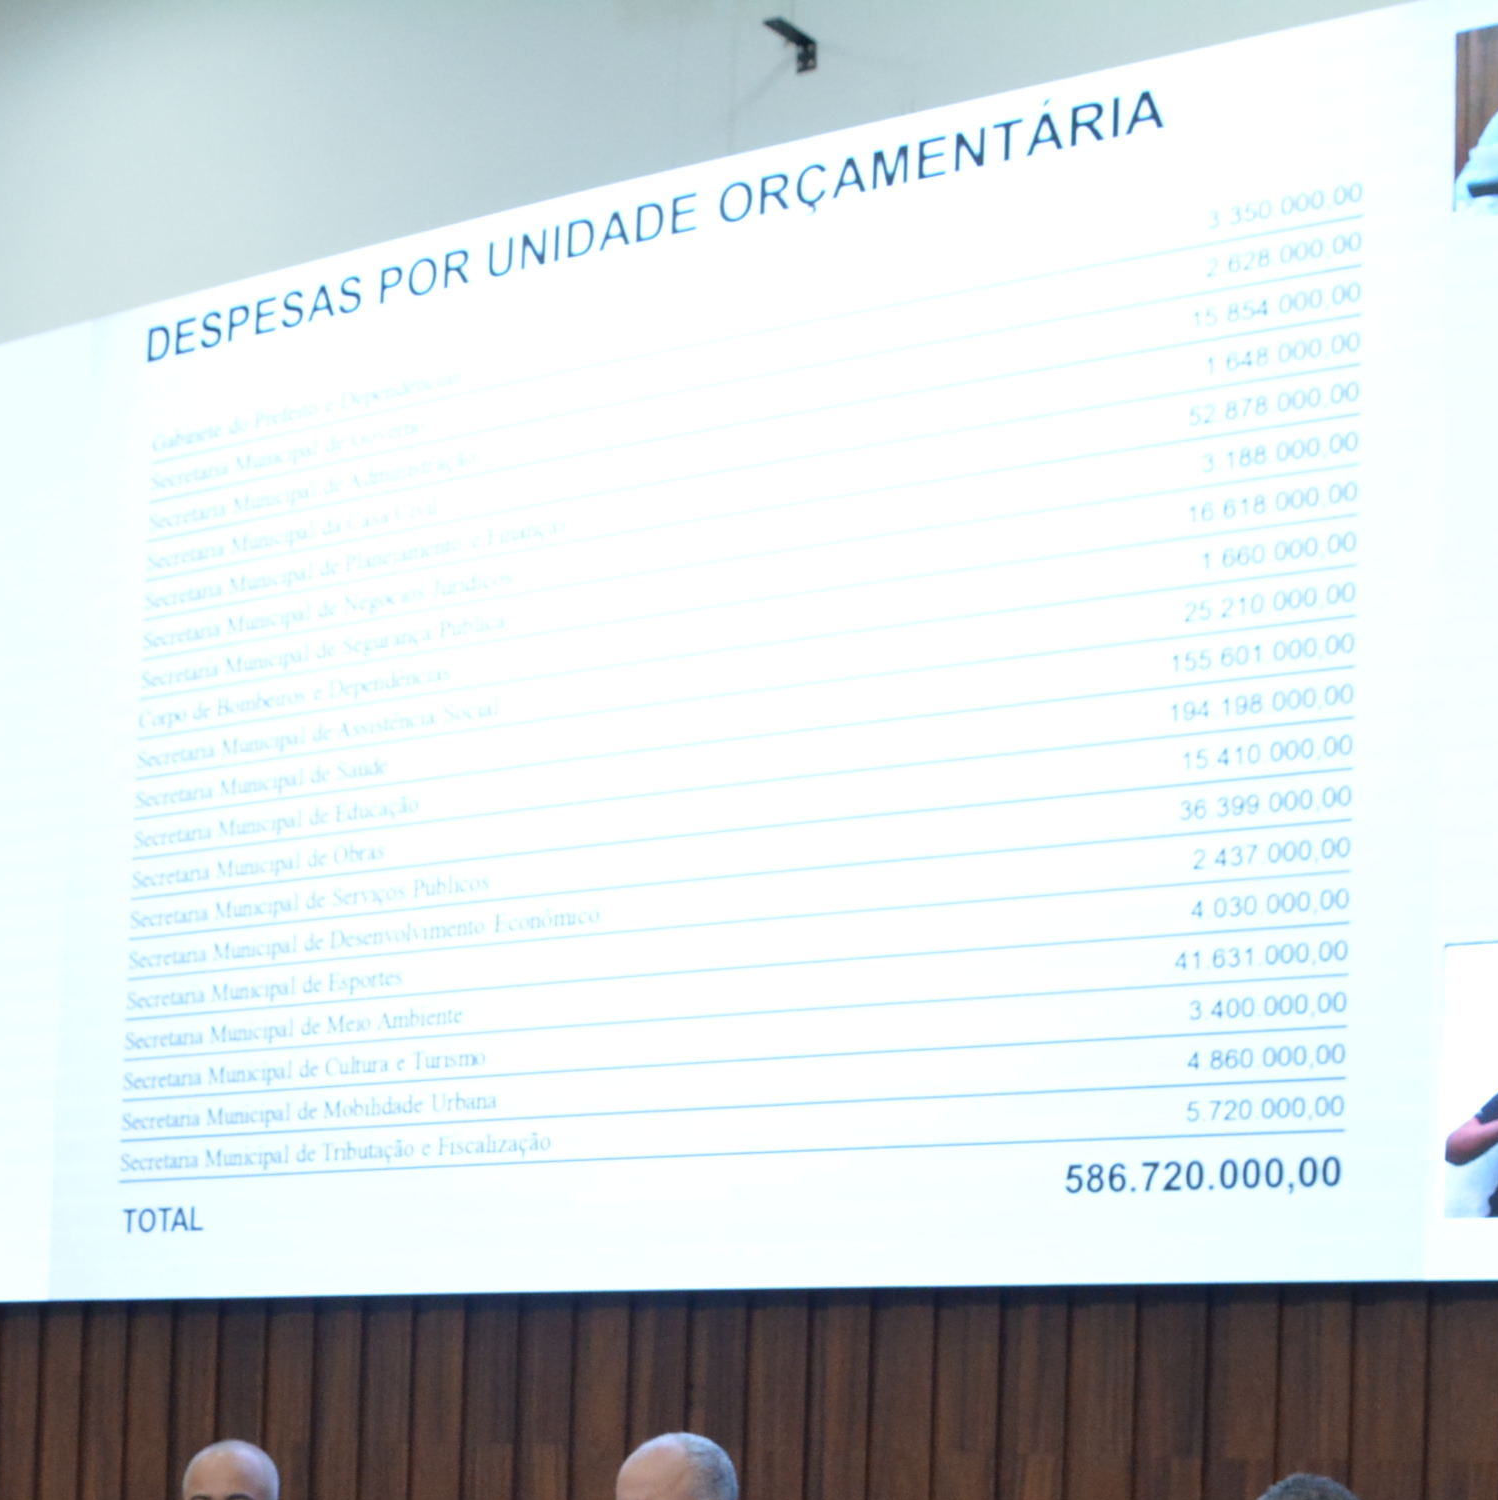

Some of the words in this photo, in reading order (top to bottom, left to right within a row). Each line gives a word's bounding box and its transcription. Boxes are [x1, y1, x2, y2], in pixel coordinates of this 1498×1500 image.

[146, 276, 362, 363] DESPESAS
[379, 249, 470, 304] POR
[487, 191, 698, 278] UNIDADE
[718, 89, 1165, 218] ORÇAMENTÁRIA
[149, 462, 229, 492] Secretaria
[235, 438, 318, 473] Municipal
[325, 434, 345, 454] de
[148, 504, 227, 534] Secretaria
[233, 480, 316, 515] Municipal
[323, 475, 343, 496] de
[145, 543, 225, 573] Secretaria
[231, 520, 315, 555] Municipal
[321, 517, 342, 537] da
[347, 511, 390, 531] Casa
[143, 583, 223, 613] Secretaria
[229, 561, 313, 596] Municipal
[319, 557, 340, 578] de
[471, 535, 481, 550] e
[141, 623, 222, 652] Secretaria
[226, 602, 311, 636] Municipal
[317, 598, 338, 620] de
[140, 663, 220, 693] Secretaria
[225, 643, 309, 676] Municipal
[316, 640, 336, 661] de
[342, 628, 432, 658] Segurança
[135, 745, 216, 776] Secretaria
[221, 725, 306, 758] Municipal
[311, 722, 333, 744] de
[444, 695, 499, 724] Social
[137, 708, 188, 736] Corpo
[192, 700, 212, 722] de
[217, 690, 306, 718] Bombeiros
[313, 687, 323, 703] e
[134, 785, 214, 811] Secretaria
[219, 767, 304, 798] Municipal
[309, 764, 331, 786] de
[337, 756, 389, 782] Saúde
[133, 826, 212, 853] Secretaria
[218, 808, 303, 838] Municipal
[308, 805, 330, 828] de
[335, 794, 420, 824] Educação
[131, 867, 210, 892] Secretaria
[217, 850, 301, 880] Municipal
[307, 847, 328, 870] de
[333, 843, 385, 866] Obras
[129, 907, 209, 931] Secretaria
[215, 891, 299, 921] Municipal
[305, 889, 326, 912] de
[332, 885, 406, 909] Serviços
[413, 874, 490, 900] Públicos
[128, 949, 207, 971] Secretaria
[213, 933, 298, 962] Municipal
[303, 931, 325, 953] de
[329, 920, 486, 951] Desenvolvimento
[494, 907, 601, 934] Econômico
[126, 989, 206, 1012] Secretaria
[211, 975, 296, 1004] Municipal
[302, 973, 323, 996] de
[328, 970, 403, 997] Esportes
[124, 1031, 204, 1052] Secretaria
[210, 1016, 294, 1046] Municipal
[300, 1015, 321, 1038] de
[327, 1013, 372, 1036] Meio
[377, 1007, 464, 1031] Ambiente
[123, 1071, 203, 1092] Secretaria
[208, 1059, 293, 1087] Municipal
[299, 1057, 320, 1080] de
[324, 1054, 390, 1078] Cultura
[396, 1057, 406, 1073] e
[412, 1049, 487, 1072] Turismo
[121, 1111, 201, 1132] Secretaria
[207, 1101, 291, 1129] Municipal
[297, 1100, 318, 1122] de
[324, 1093, 424, 1120] Mobilidade
[432, 1090, 498, 1114] Urbana
[120, 1152, 199, 1173] Secretaria
[205, 1143, 289, 1171] Municipal
[296, 1142, 317, 1164] de
[322, 1138, 415, 1165] Tributação
[421, 1141, 432, 1158] e
[438, 1130, 552, 1158] Fiscalização
[1064, 1155, 1342, 1195] 586.720.000,00
[122, 1206, 205, 1234] TOTAL
